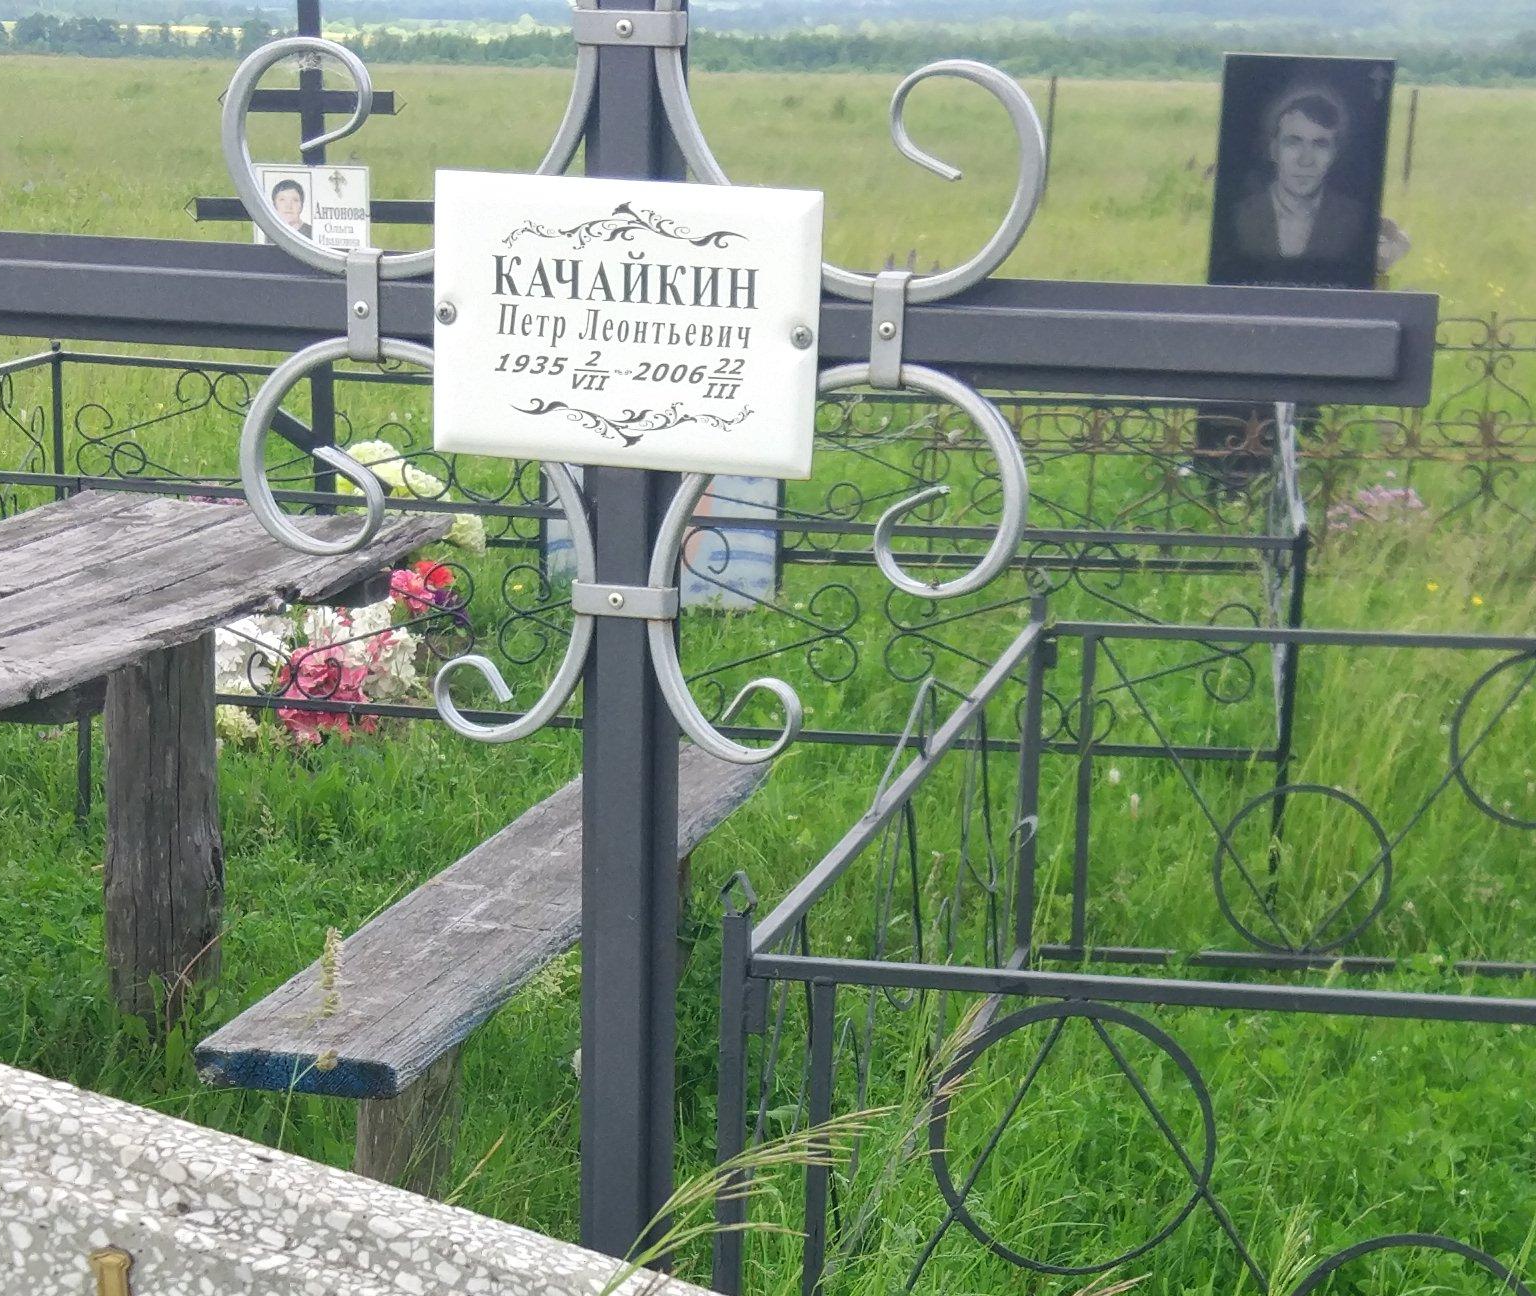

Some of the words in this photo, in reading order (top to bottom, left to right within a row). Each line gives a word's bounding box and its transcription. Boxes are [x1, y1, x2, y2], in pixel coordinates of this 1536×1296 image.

[491, 251, 760, 309] КАЧАЙКИН
[496, 303, 566, 347] Петр
[579, 308, 752, 349] Леонтьевич
[494, 353, 568, 376] 1935
[584, 351, 601, 367] 2
[632, 362, 707, 384] 2006
[712, 358, 745, 375] 22
